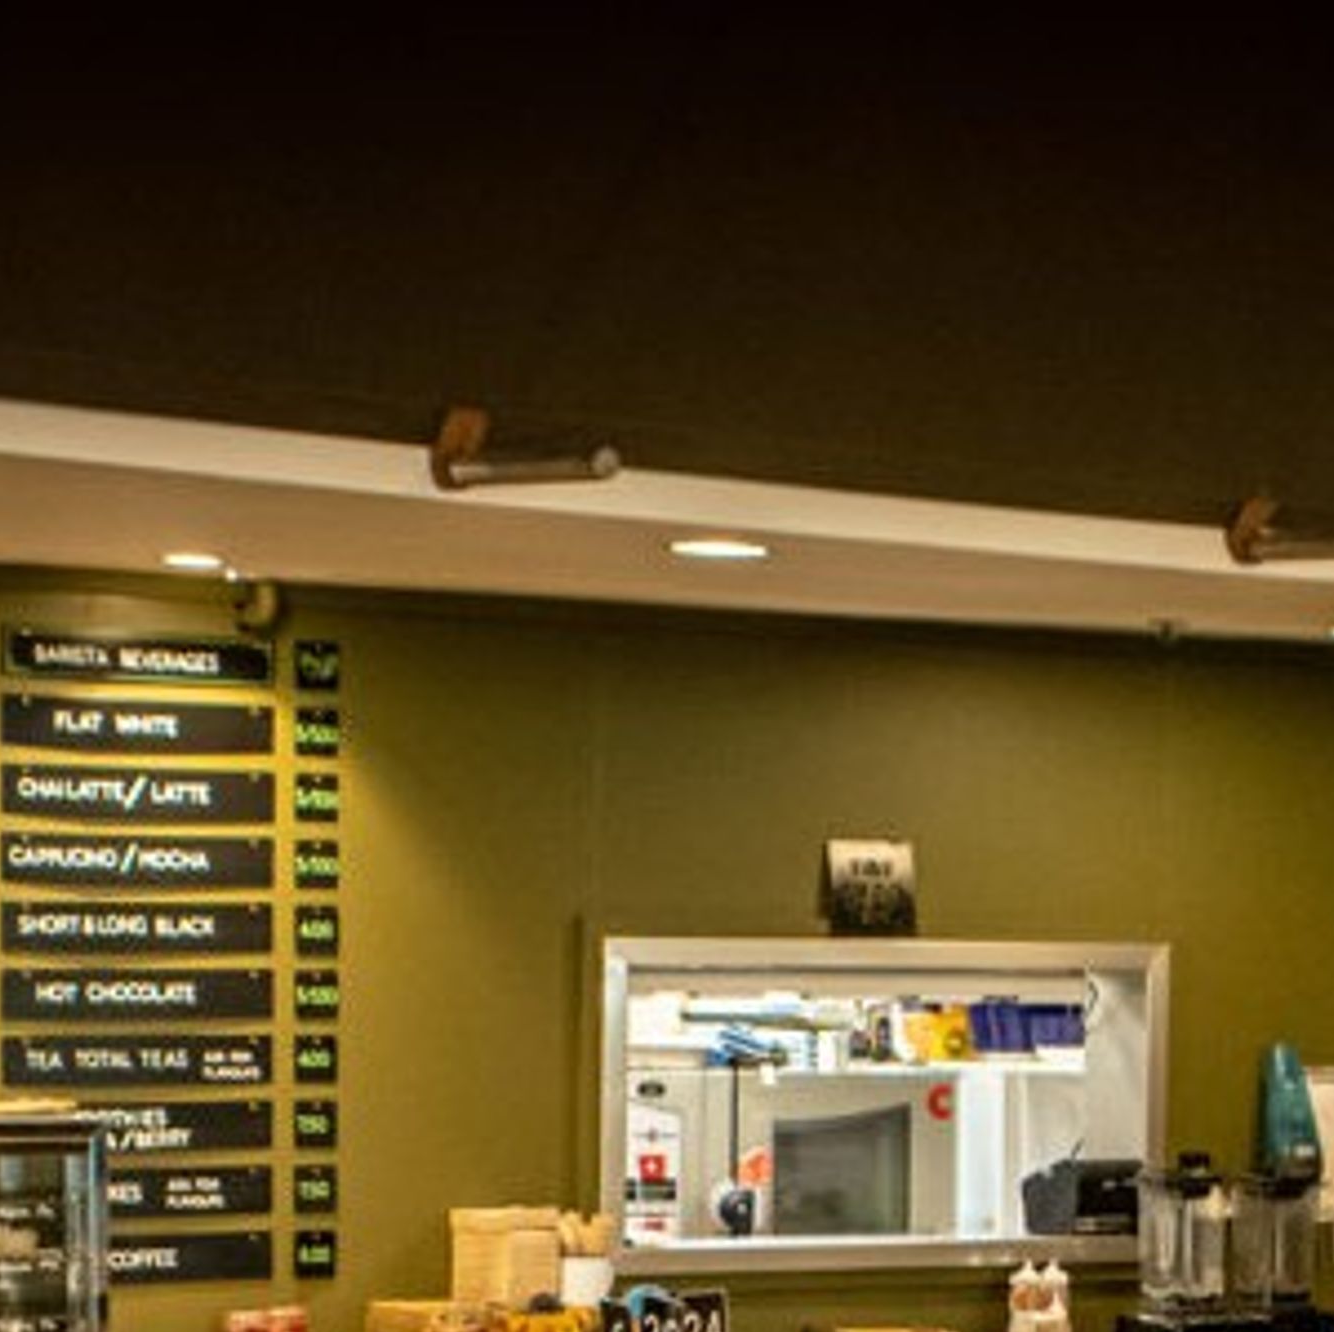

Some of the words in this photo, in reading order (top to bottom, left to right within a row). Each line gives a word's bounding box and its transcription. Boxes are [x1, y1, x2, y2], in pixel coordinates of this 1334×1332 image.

[34, 643, 110, 666] BARISTA
[120, 647, 220, 675] BEVERAGES
[53, 709, 104, 734] FLAT
[115, 713, 179, 739] WHITE
[18, 914, 80, 937] SHORT
[96, 914, 148, 937] LONG
[154, 914, 215, 938] BLACK
[35, 981, 78, 1005] HOT
[85, 981, 197, 1006] CHOCOLATE
[26, 1049, 65, 1070] TEA
[75, 1049, 132, 1069] TOTAL
[141, 1048, 189, 1069] TEAS
[105, 1247, 179, 1271] COFFEE
